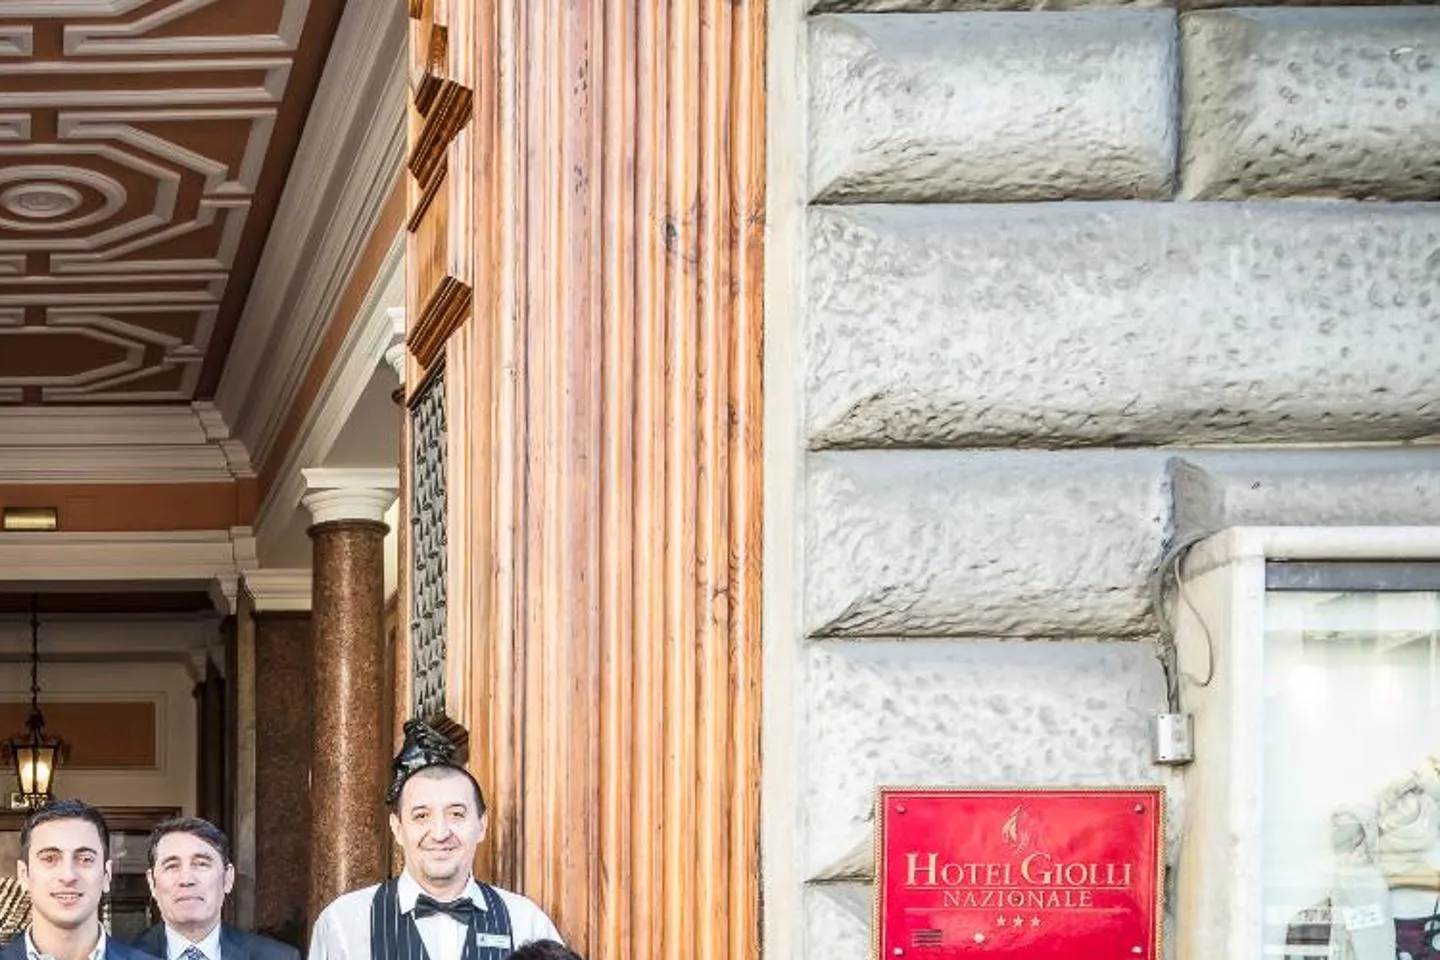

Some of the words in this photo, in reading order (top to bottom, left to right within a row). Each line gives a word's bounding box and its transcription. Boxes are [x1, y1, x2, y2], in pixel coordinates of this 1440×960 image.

[906, 852, 1017, 886] HOTEL
[1020, 852, 1132, 886] GIOLLI
[943, 890, 1094, 908] NAZIONALE
